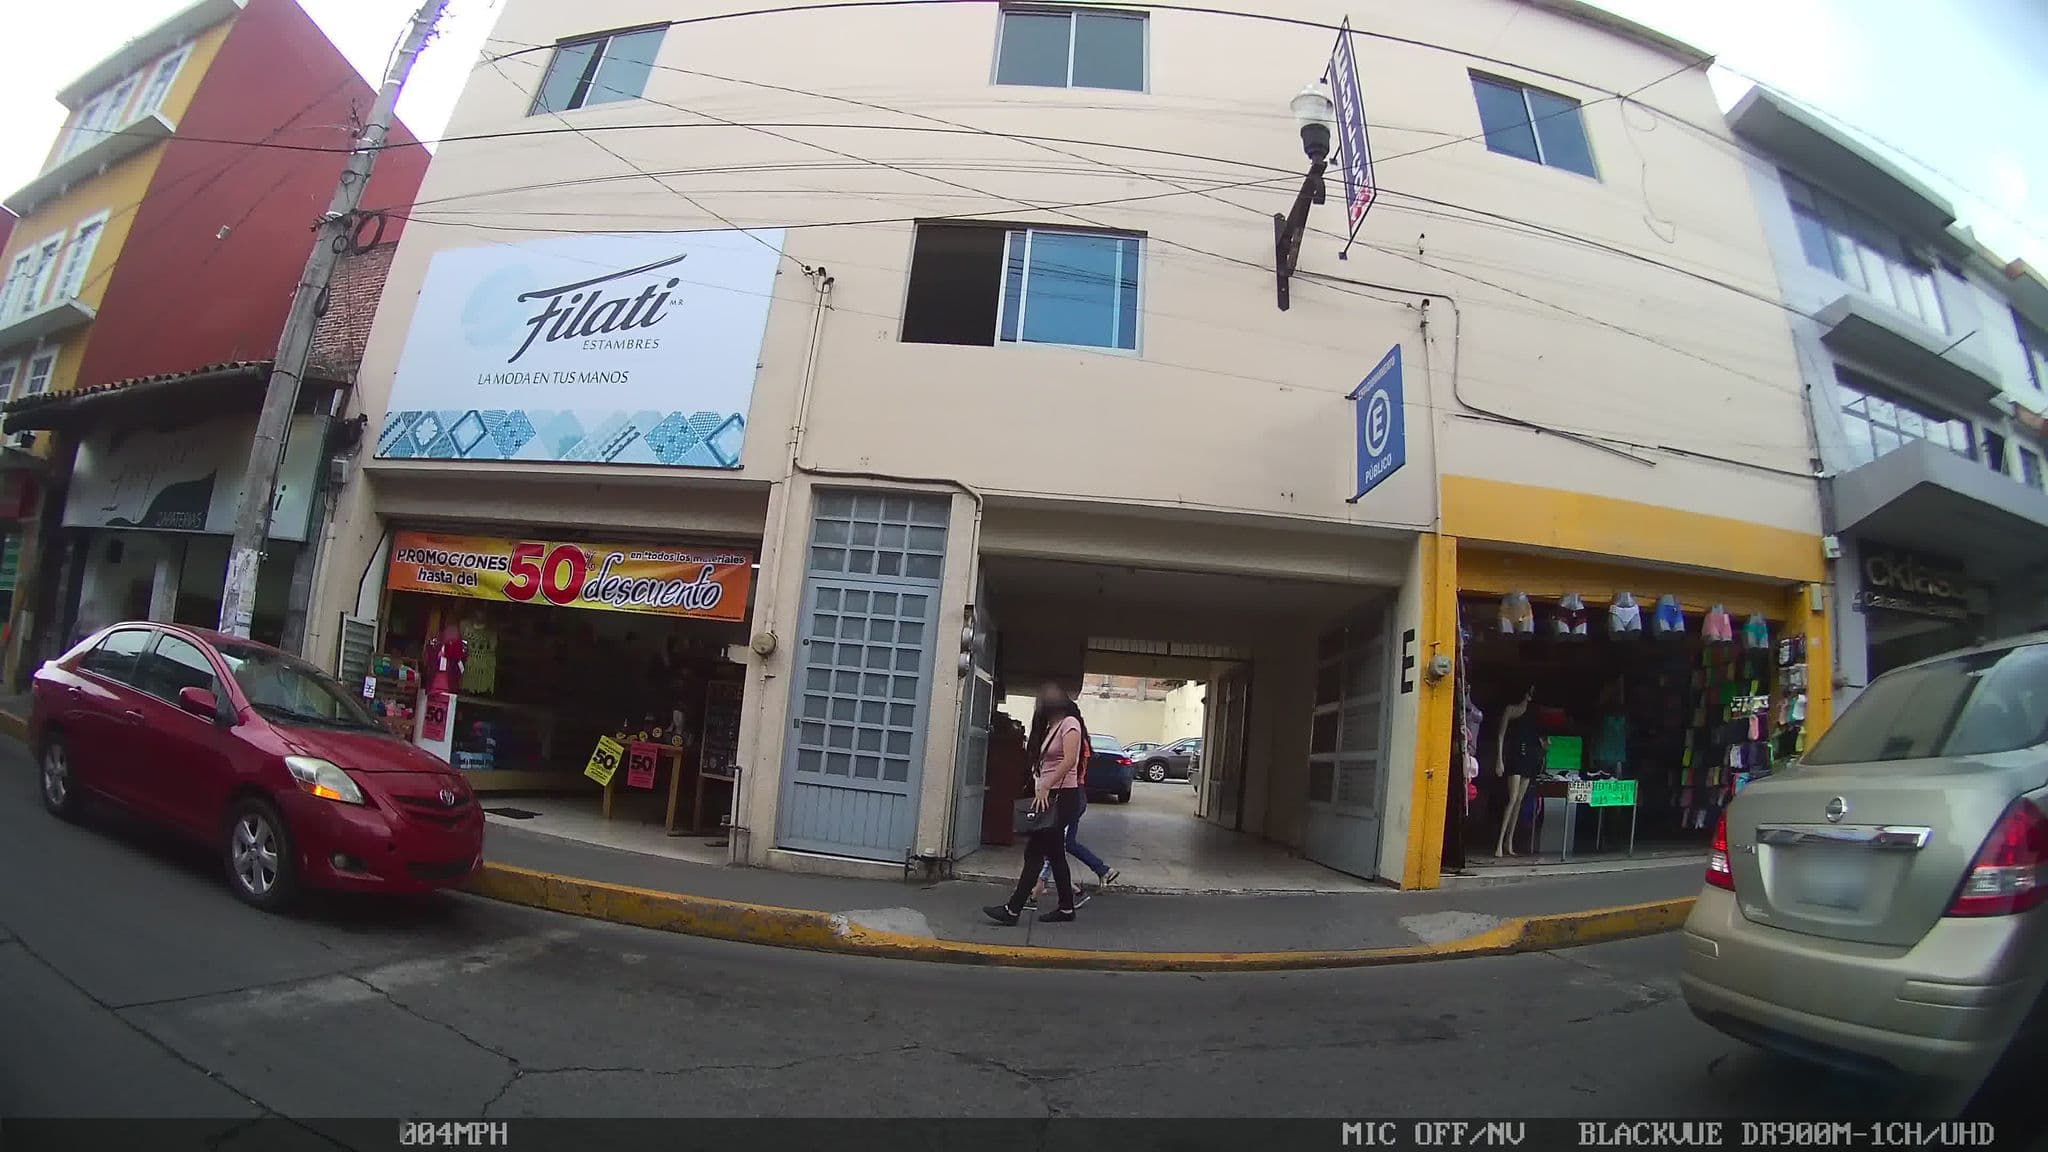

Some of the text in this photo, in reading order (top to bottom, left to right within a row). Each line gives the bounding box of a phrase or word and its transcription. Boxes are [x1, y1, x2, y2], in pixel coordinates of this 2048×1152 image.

[508, 253, 687, 363] Filati
[582, 338, 660, 350] ESTAMBRES
[478, 371, 629, 385] LA MODA EN TUS MANOS
[1365, 453, 1392, 484] PÚBLICO
[396, 549, 509, 571] PROMOCIONES
[630, 551, 642, 560] en
[676, 552, 691, 563] los
[692, 554, 746, 565] meriales
[417, 567, 479, 587] hasta del
[582, 551, 722, 610] descuento
[1401, 629, 1415, 694] E
